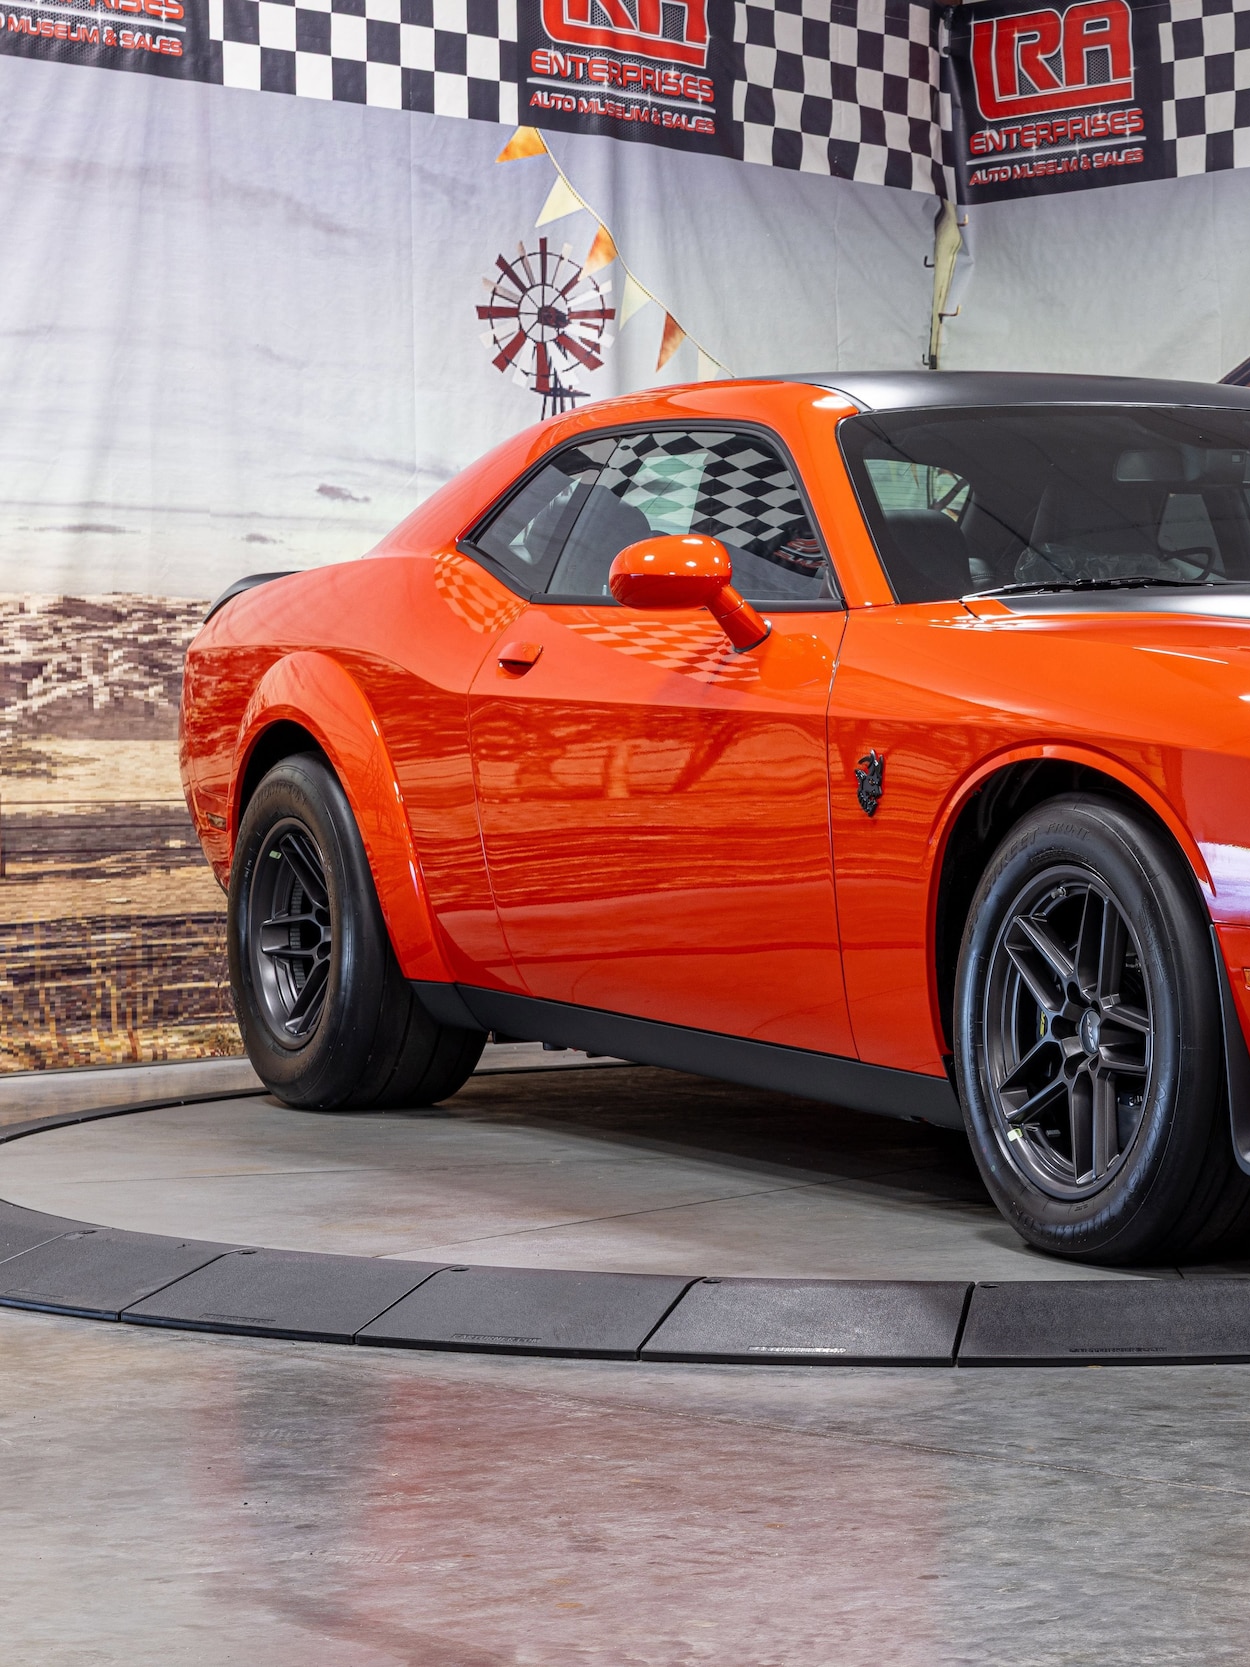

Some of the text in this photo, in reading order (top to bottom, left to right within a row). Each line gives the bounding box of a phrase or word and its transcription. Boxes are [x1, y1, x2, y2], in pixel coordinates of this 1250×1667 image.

[7, 13, 183, 57] MUSEUM & SALES
[530, 48, 715, 103] ENTERPRISES
[970, 0, 1135, 122] IRA
[529, 91, 716, 135] AUTO MUSEUM & SALES
[969, 108, 1145, 155] ENTERPRISES
[969, 147, 1144, 186] AUTO MUSEUM & SALES
